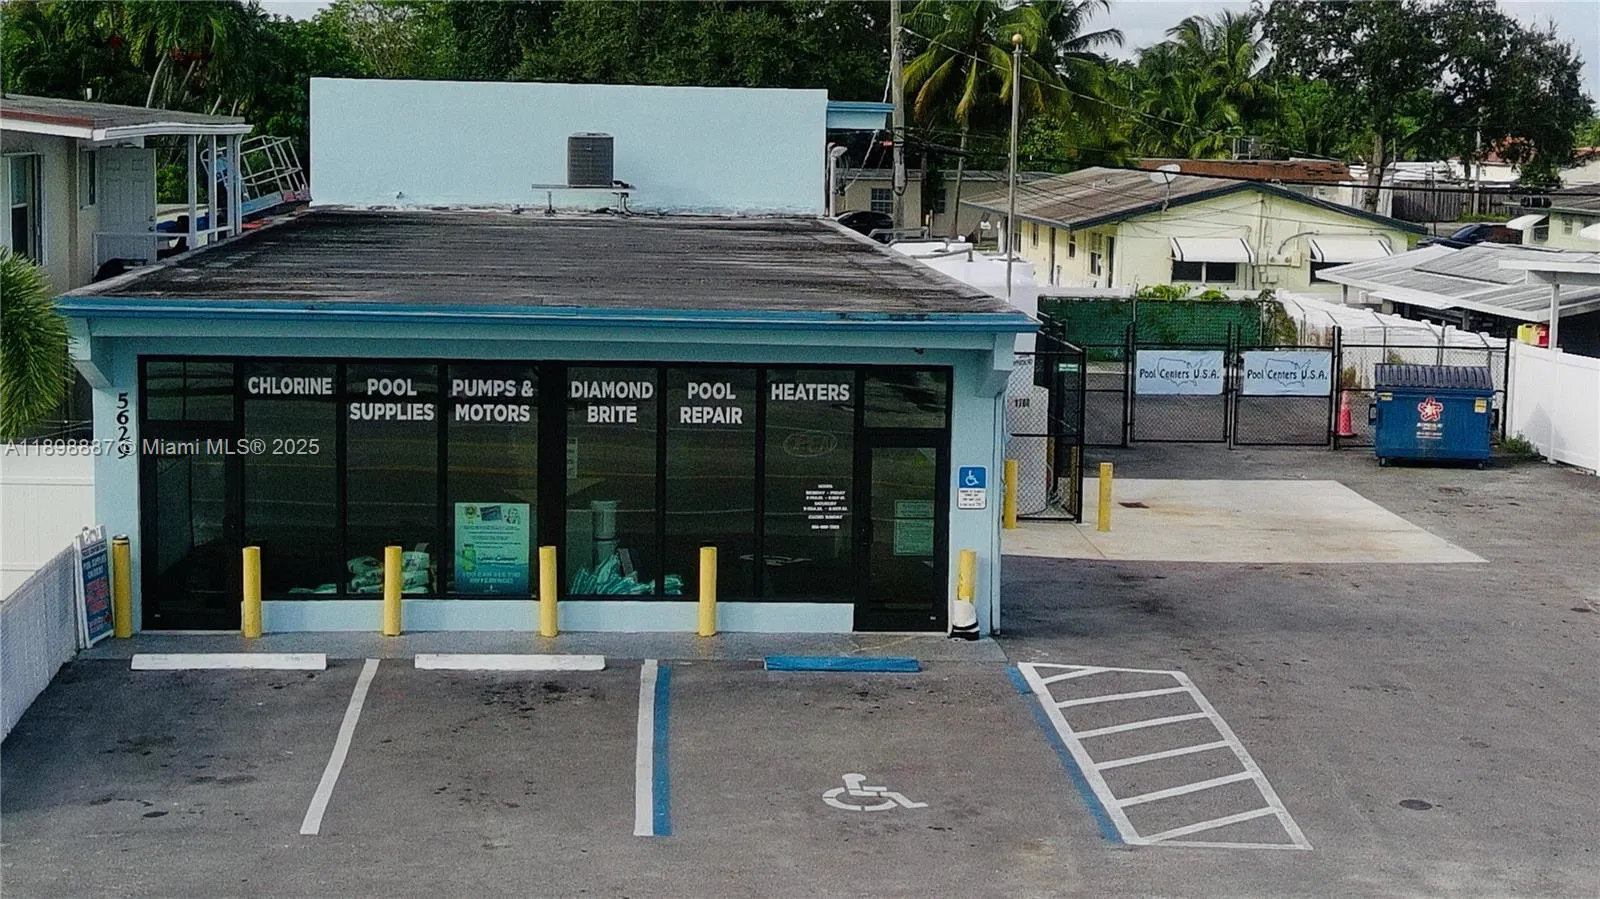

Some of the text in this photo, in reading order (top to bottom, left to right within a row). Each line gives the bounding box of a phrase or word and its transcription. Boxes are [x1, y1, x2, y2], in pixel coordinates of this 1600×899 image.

[1139, 368, 1220, 380] Pool Centers U.S.A.
[1247, 369, 1328, 381] Pool Centers U.S.A.
[248, 376, 333, 396] CHLORINE
[366, 378, 419, 397] POOL
[451, 379, 535, 398] PUMPS &
[570, 380, 654, 400] DIAMOND
[687, 382, 737, 400] POOL
[770, 383, 850, 402] HEATERS
[349, 402, 435, 422] SUPPLIES
[455, 404, 531, 422] MOTORS
[586, 405, 638, 424] BRITE
[679, 407, 743, 425] REPAIR
